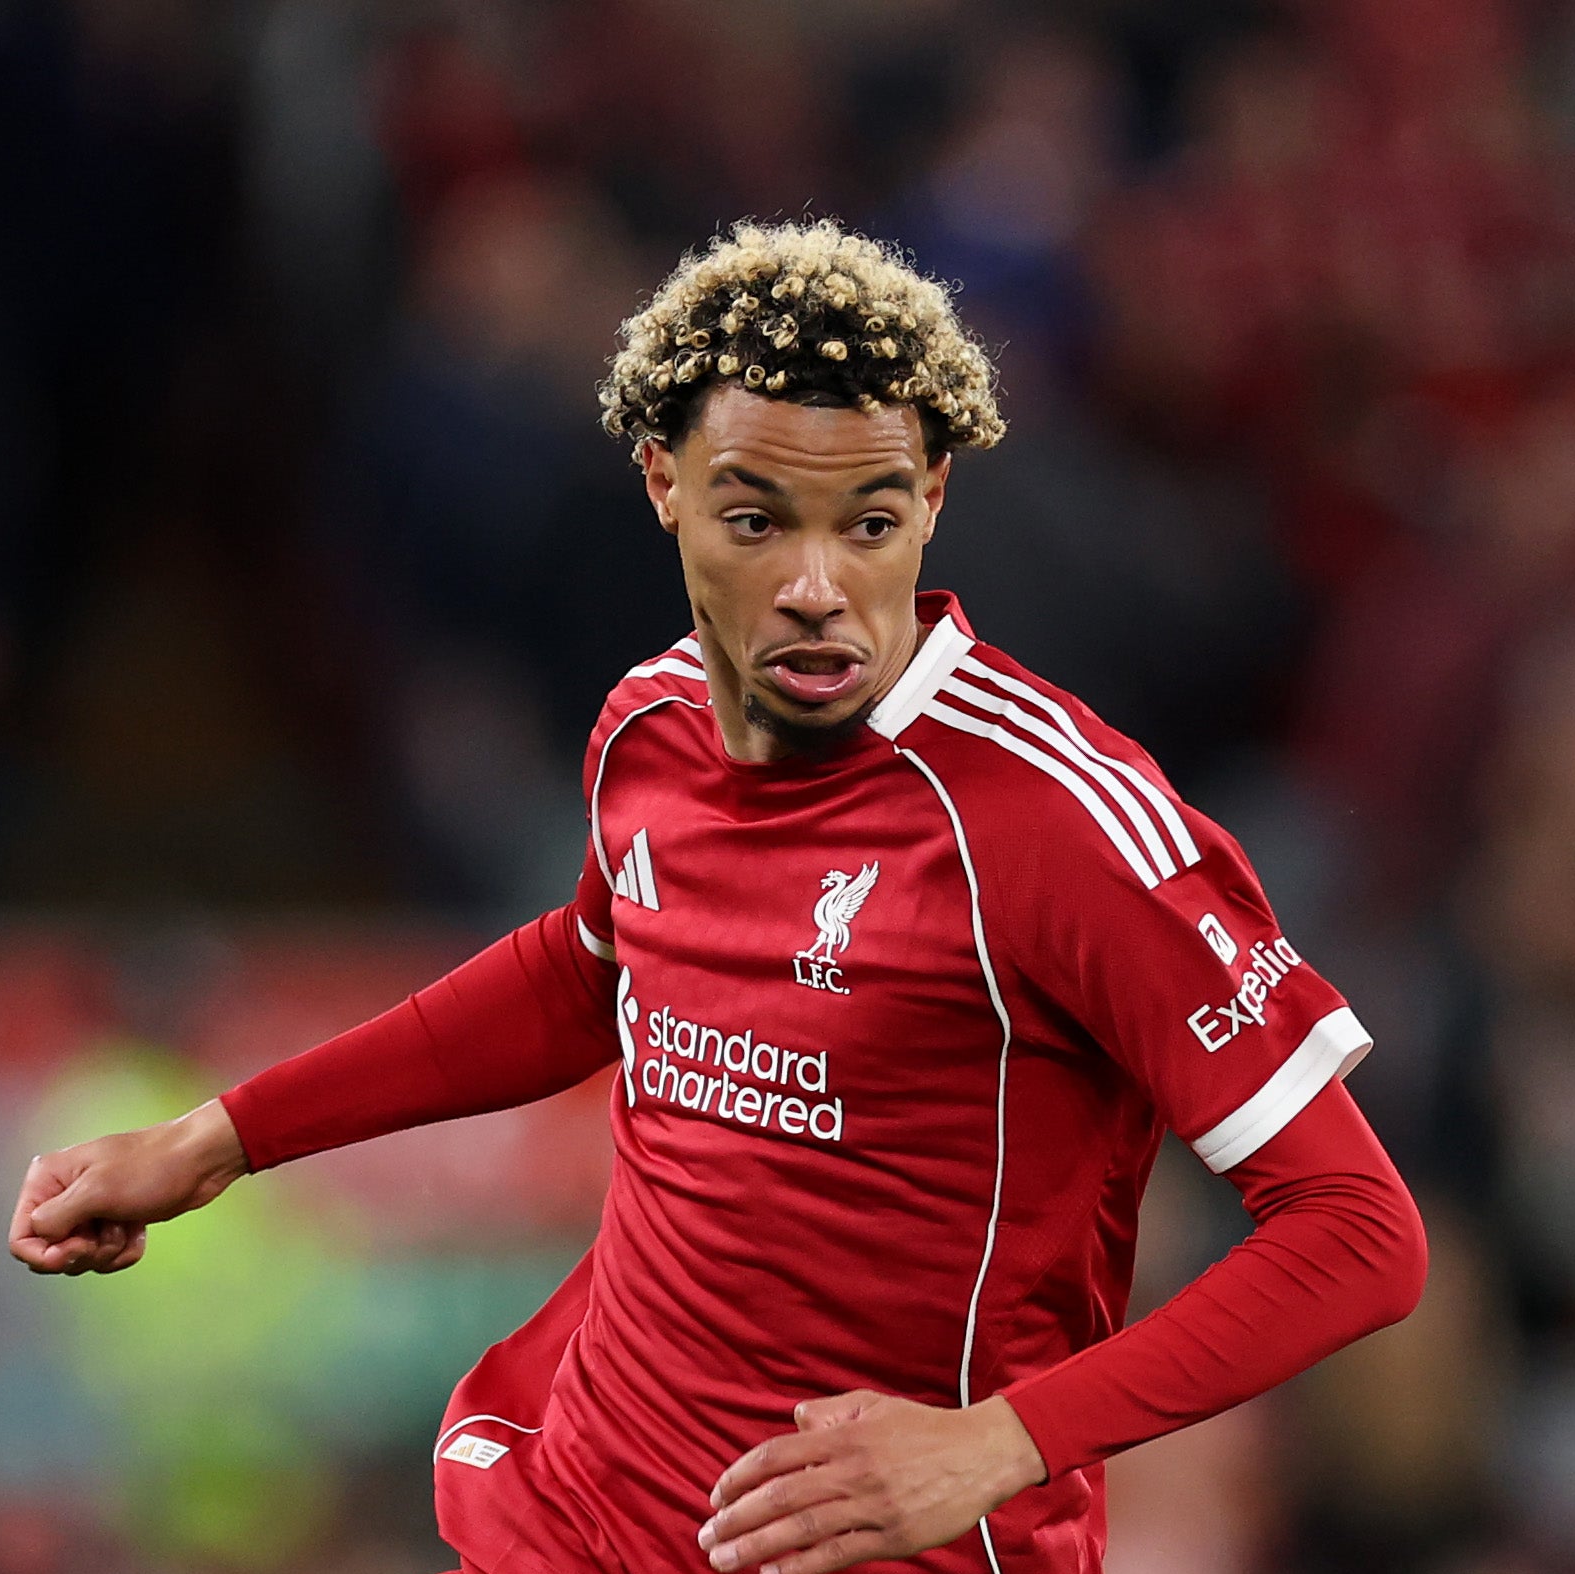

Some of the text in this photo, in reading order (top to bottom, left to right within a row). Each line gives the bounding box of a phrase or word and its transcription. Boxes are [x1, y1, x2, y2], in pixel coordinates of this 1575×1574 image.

[792, 958, 850, 995] L.F.C.
[1187, 936, 1302, 1053] Expedia
[647, 1005, 827, 1094] standard
[642, 1053, 844, 1142] chartered
